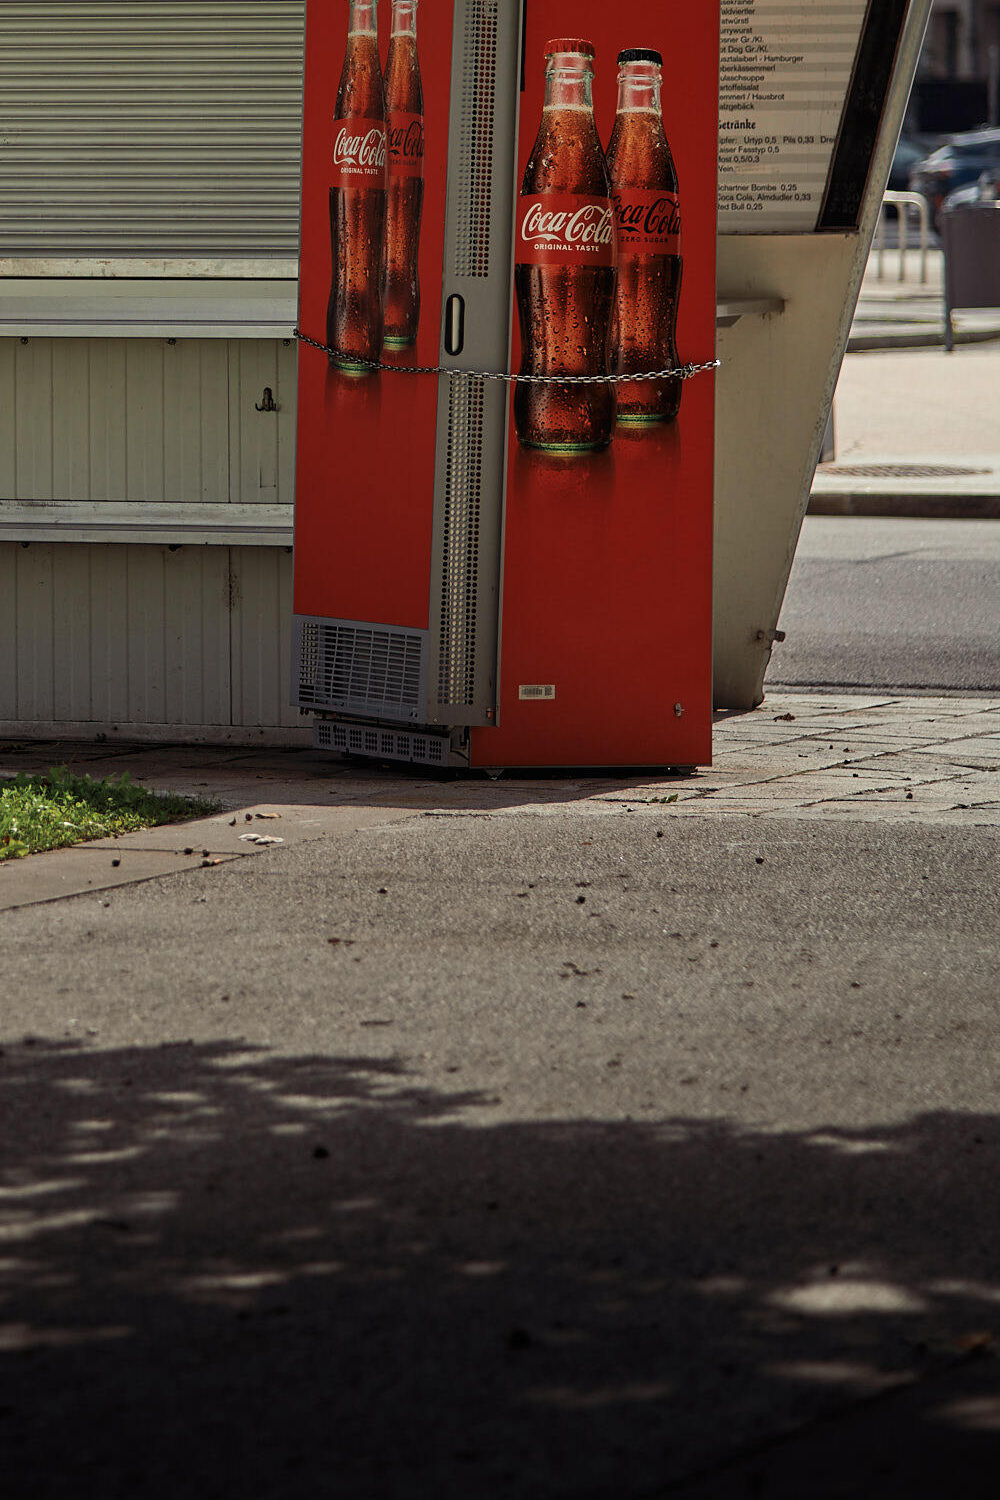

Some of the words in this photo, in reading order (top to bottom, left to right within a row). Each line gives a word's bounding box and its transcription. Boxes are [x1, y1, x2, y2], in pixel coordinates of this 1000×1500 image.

[720, 7, 756, 15] aldviertler
[728, 45, 743, 54] Dog
[763, 55, 804, 64] Hamburger
[720, 74, 765, 82] ulaschsuppe
[719, 83, 759, 91] artoffelsalat
[719, 102, 754, 111] alzgebäck
[765, 136, 777, 144] 0,5
[798, 136, 814, 144] 0,33
[767, 146, 779, 154] 0,5
[751, 184, 776, 192] Bombe
[781, 184, 797, 193] 0,25
[757, 193, 793, 201] Almdudler
[794, 194, 811, 202] 0,33
[746, 203, 764, 211] 0,25
[521, 202, 613, 244] Coca-Cola
[534, 243, 573, 251] ORIGINAL
[575, 244, 600, 252] TASTE
